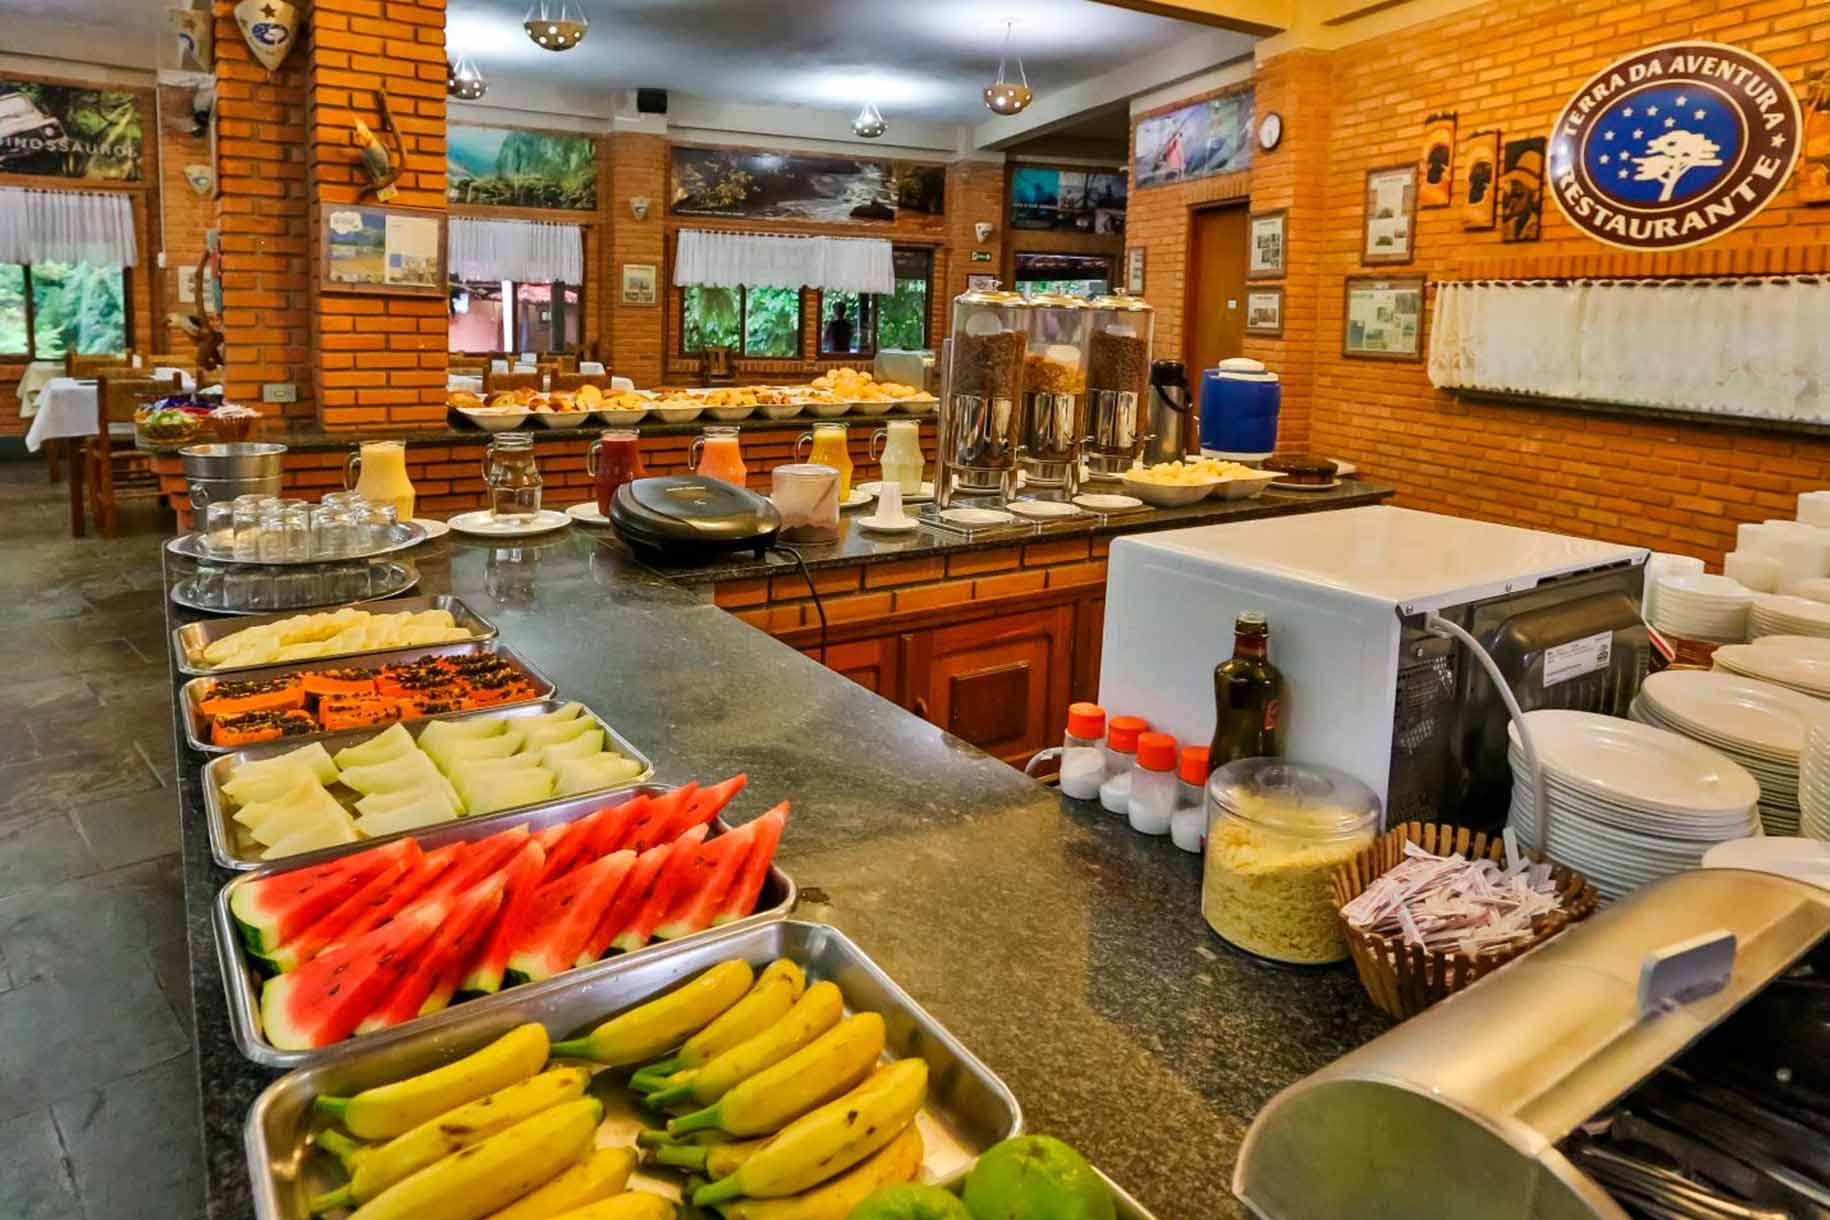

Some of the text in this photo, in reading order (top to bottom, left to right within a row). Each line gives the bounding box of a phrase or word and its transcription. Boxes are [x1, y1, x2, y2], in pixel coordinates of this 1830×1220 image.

[1564, 55, 1785, 136] TERRA DA AVENTURA
[1558, 154, 1781, 240] RESTAURANTE
